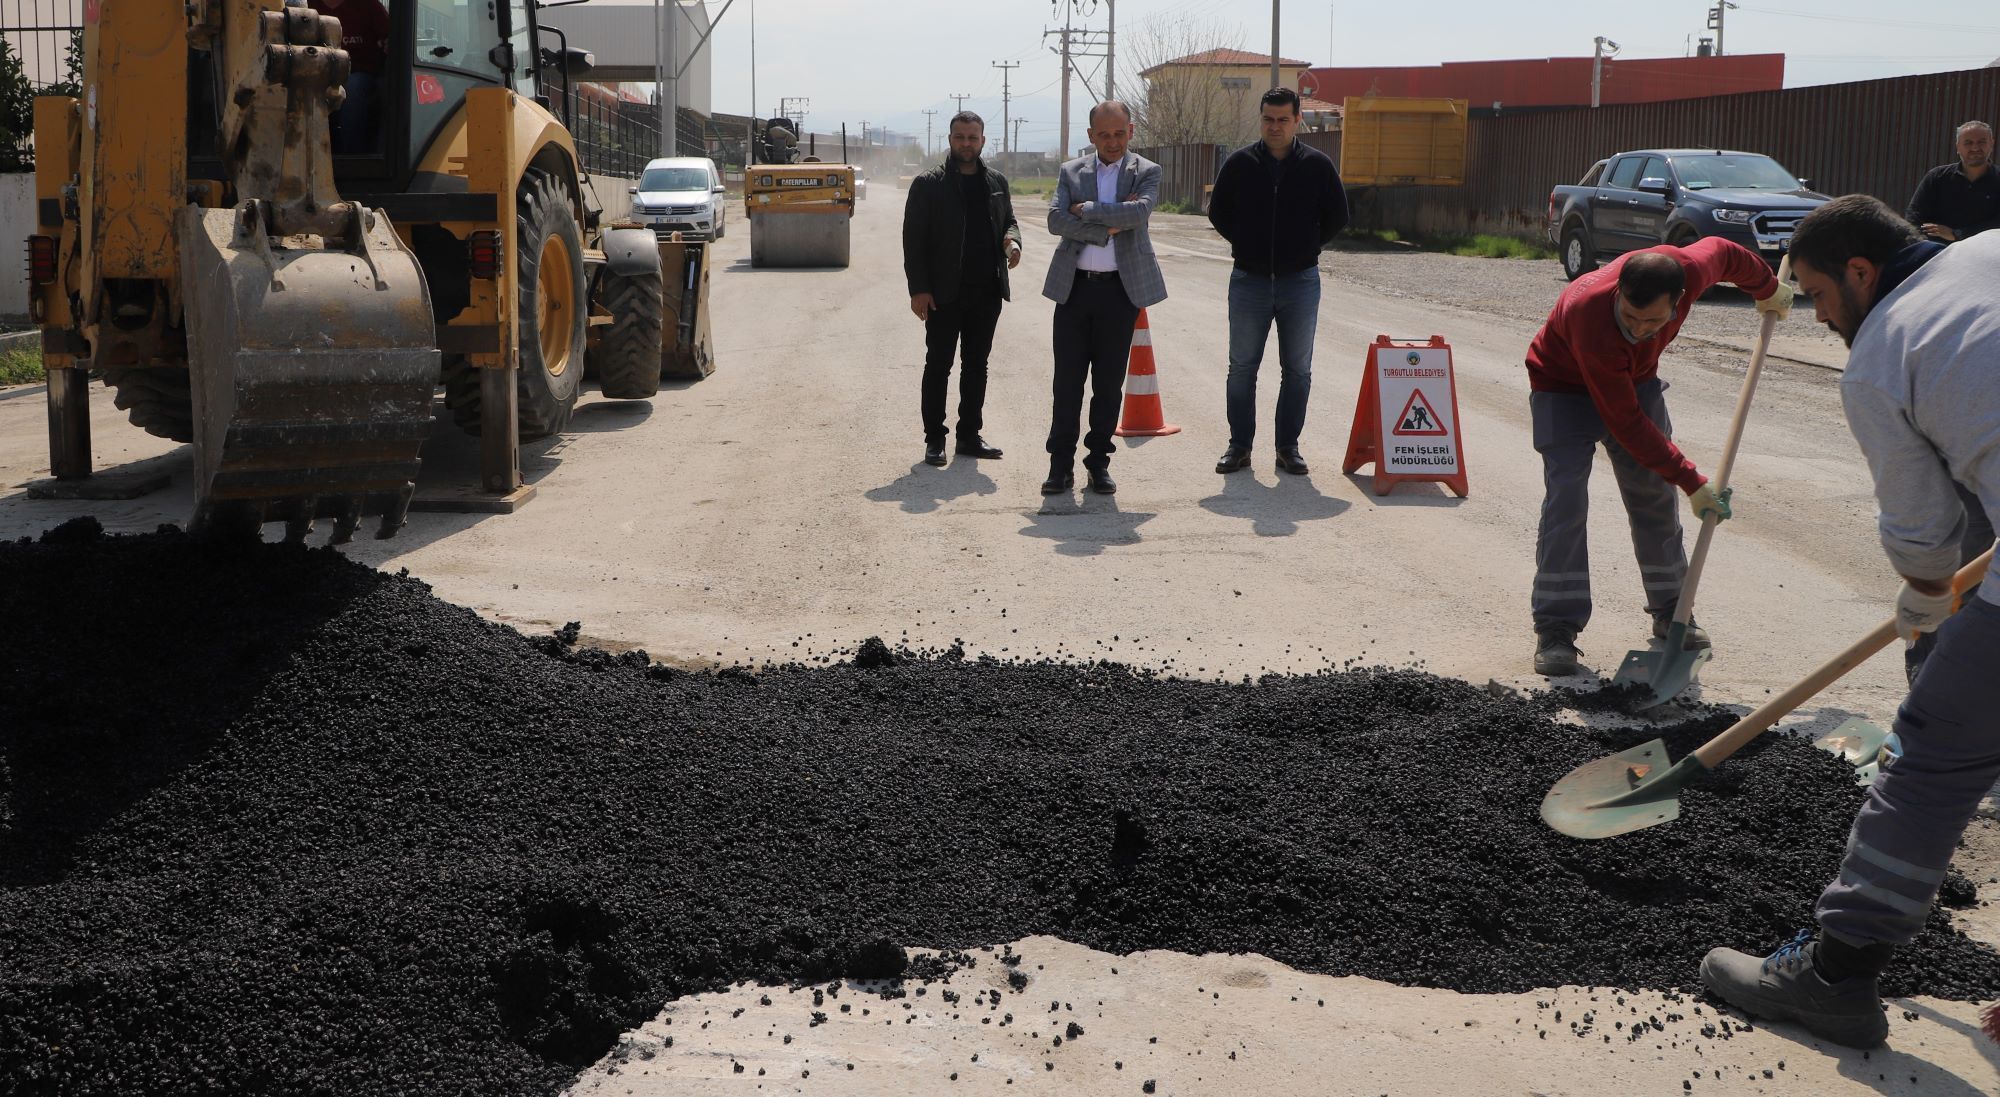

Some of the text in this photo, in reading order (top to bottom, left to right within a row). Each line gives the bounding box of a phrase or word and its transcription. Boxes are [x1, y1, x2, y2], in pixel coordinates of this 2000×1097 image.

[781, 178, 818, 186] CATERPILLAR
[1384, 368, 1446, 377] TURGUTLU BELEDİYESİ
[1395, 444, 1449, 455] FEN İŞLERİ
[1391, 455, 1454, 465] MÜDÜRLÜĞÜ
